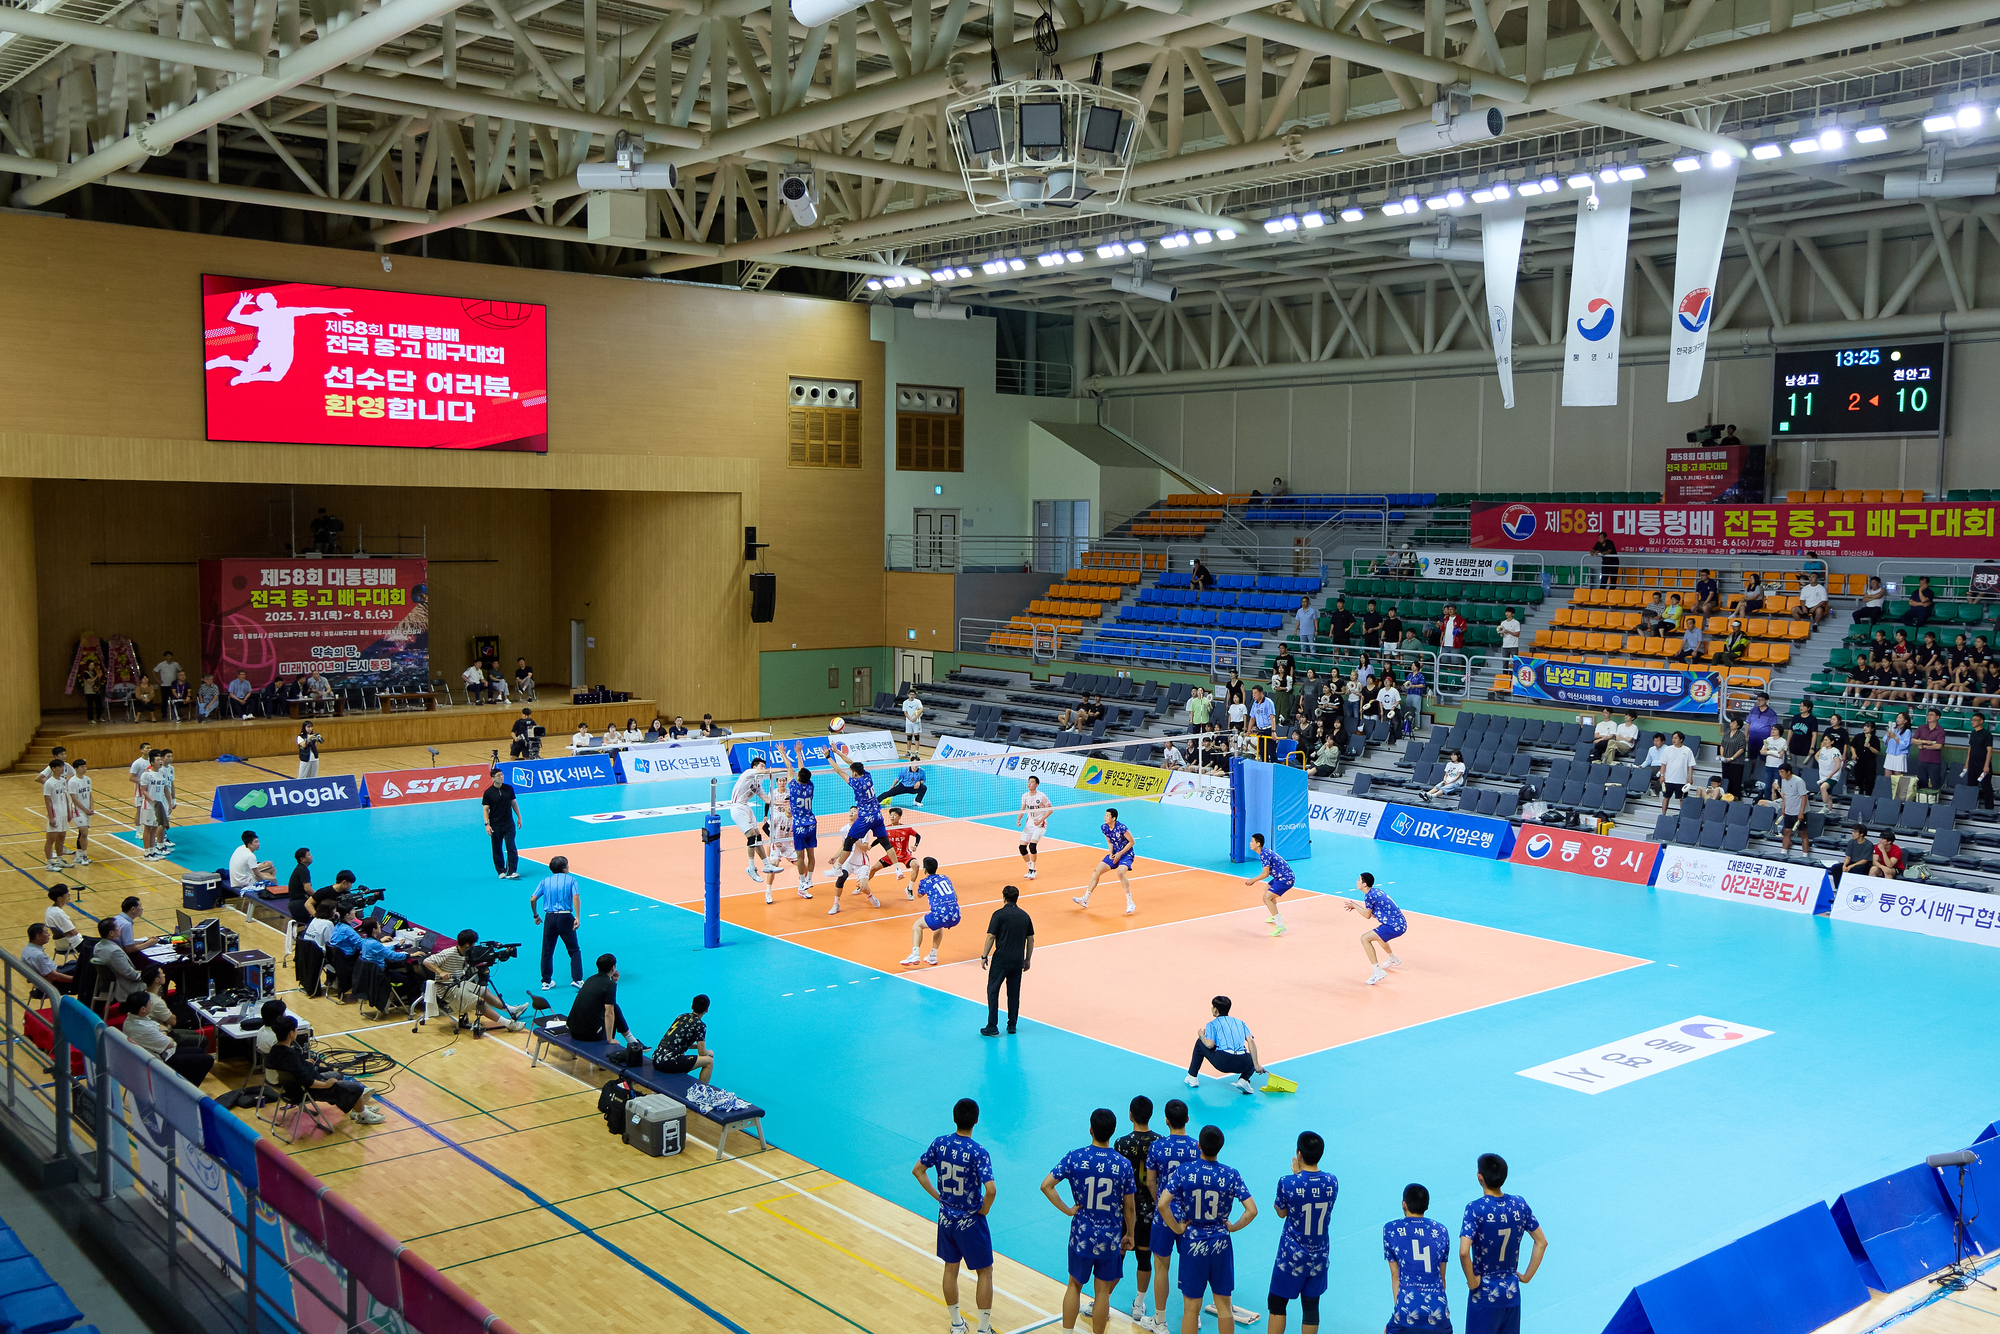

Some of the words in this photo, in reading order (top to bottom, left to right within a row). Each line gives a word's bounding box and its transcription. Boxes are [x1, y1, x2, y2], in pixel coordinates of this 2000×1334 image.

[325, 320, 384, 337] 제58회
[389, 324, 459, 342] 대통령배
[326, 335, 369, 356] 전국
[374, 338, 421, 359] 중·고
[427, 342, 505, 365] 배구대회
[1835, 349, 1881, 367] 13:25
[324, 366, 416, 393] 선수단
[426, 372, 519, 400] 여러분,
[1785, 374, 1819, 386] 남성고
[1893, 368, 1931, 382] 천안고
[324, 394, 476, 422] 환영합니다
[1788, 392, 1812, 416] 11
[1848, 392, 1860, 411] 2
[1896, 386, 1928, 412] 10
[1670, 452, 1696, 462] 제58회
[1544, 508, 1602, 534] 제58회
[1612, 510, 1714, 537] 대통령배
[1724, 510, 1778, 538] 전국
[1788, 510, 1855, 538] 중·고
[1866, 508, 1995, 538] 배구대회
[1804, 540, 1840, 548] 통영체육관
[1433, 558, 1454, 566] 우리는
[1455, 558, 1476, 567] 너희만
[1478, 559, 1492, 568] 보여
[1438, 567, 1453, 576] 최강
[260, 568, 323, 587] 제58회
[328, 568, 396, 586] 대통령배
[250, 590, 286, 608] 전국
[292, 590, 333, 608] 중·고
[338, 588, 406, 607] 배구대회
[265, 612, 296, 622] 2025.
[298, 611, 307, 622] 7.
[353, 610, 363, 620] 8.
[311, 646, 343, 658] 약속의
[280, 662, 301, 675] 미래
[346, 660, 368, 672] 도시
[370, 659, 391, 670] 통영
[1520, 670, 1532, 682] 최
[1545, 666, 1590, 687] 남성고
[1594, 671, 1627, 690] 배구
[1632, 674, 1682, 694] 화이팅
[1694, 684, 1707, 697] 강
[1020, 757, 1079, 777] 통영시체육회
[1103, 769, 1164, 792] 통영관광개발공사
[268, 782, 349, 807] Hogak
[1727, 859, 1762, 876] 대한민국
[1763, 865, 1788, 880] 제1호
[933, 880, 953, 896] 10
[1721, 873, 1810, 906] 야간관광도시
[941, 1161, 965, 1196] 25
[1084, 1176, 1113, 1211] 12
[1296, 1186, 1333, 1198] 박민규
[1192, 1189, 1219, 1220] 13
[1302, 1202, 1328, 1236] 17
[1498, 1228, 1511, 1261] 7
[1412, 1239, 1432, 1273] 4
